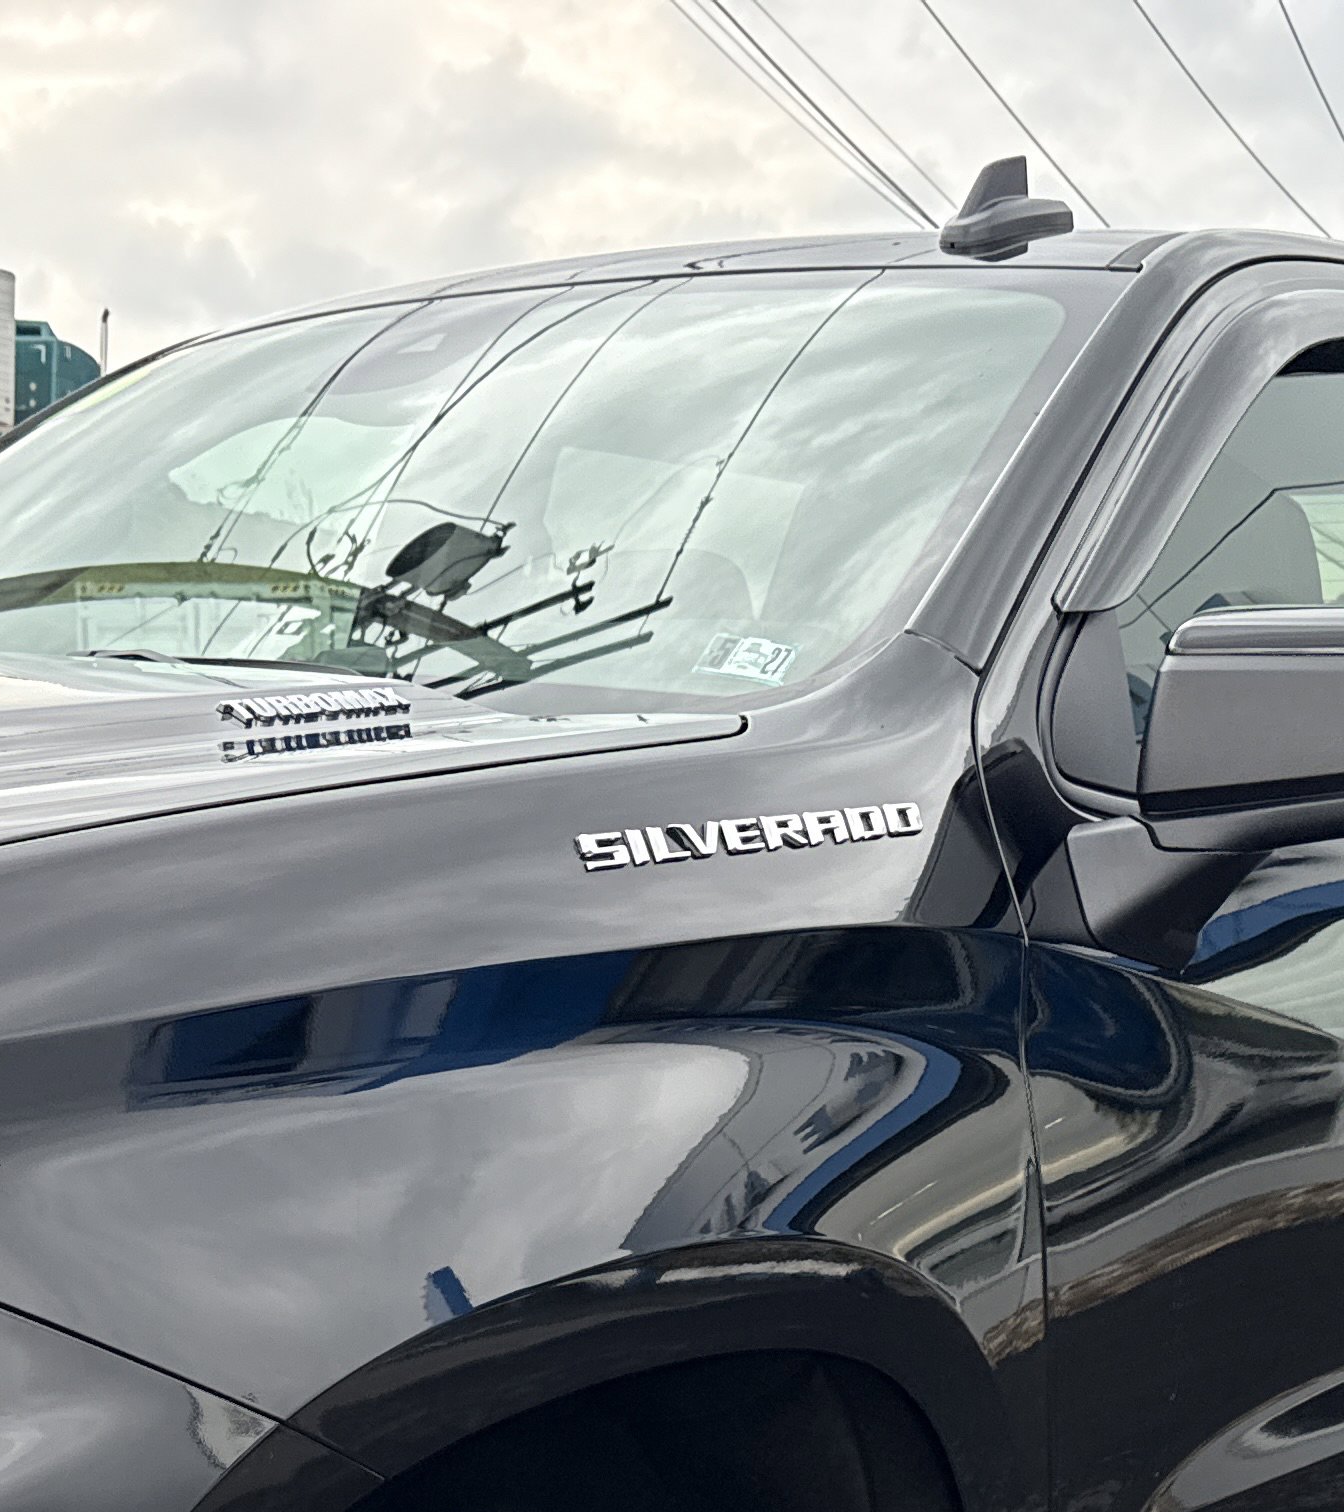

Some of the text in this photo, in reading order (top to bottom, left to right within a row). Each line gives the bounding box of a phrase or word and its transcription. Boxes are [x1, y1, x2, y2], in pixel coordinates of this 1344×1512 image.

[759, 647, 793, 676] 27
[216, 687, 412, 729] TURBOMAX
[574, 801, 924, 873] SILVERADO
